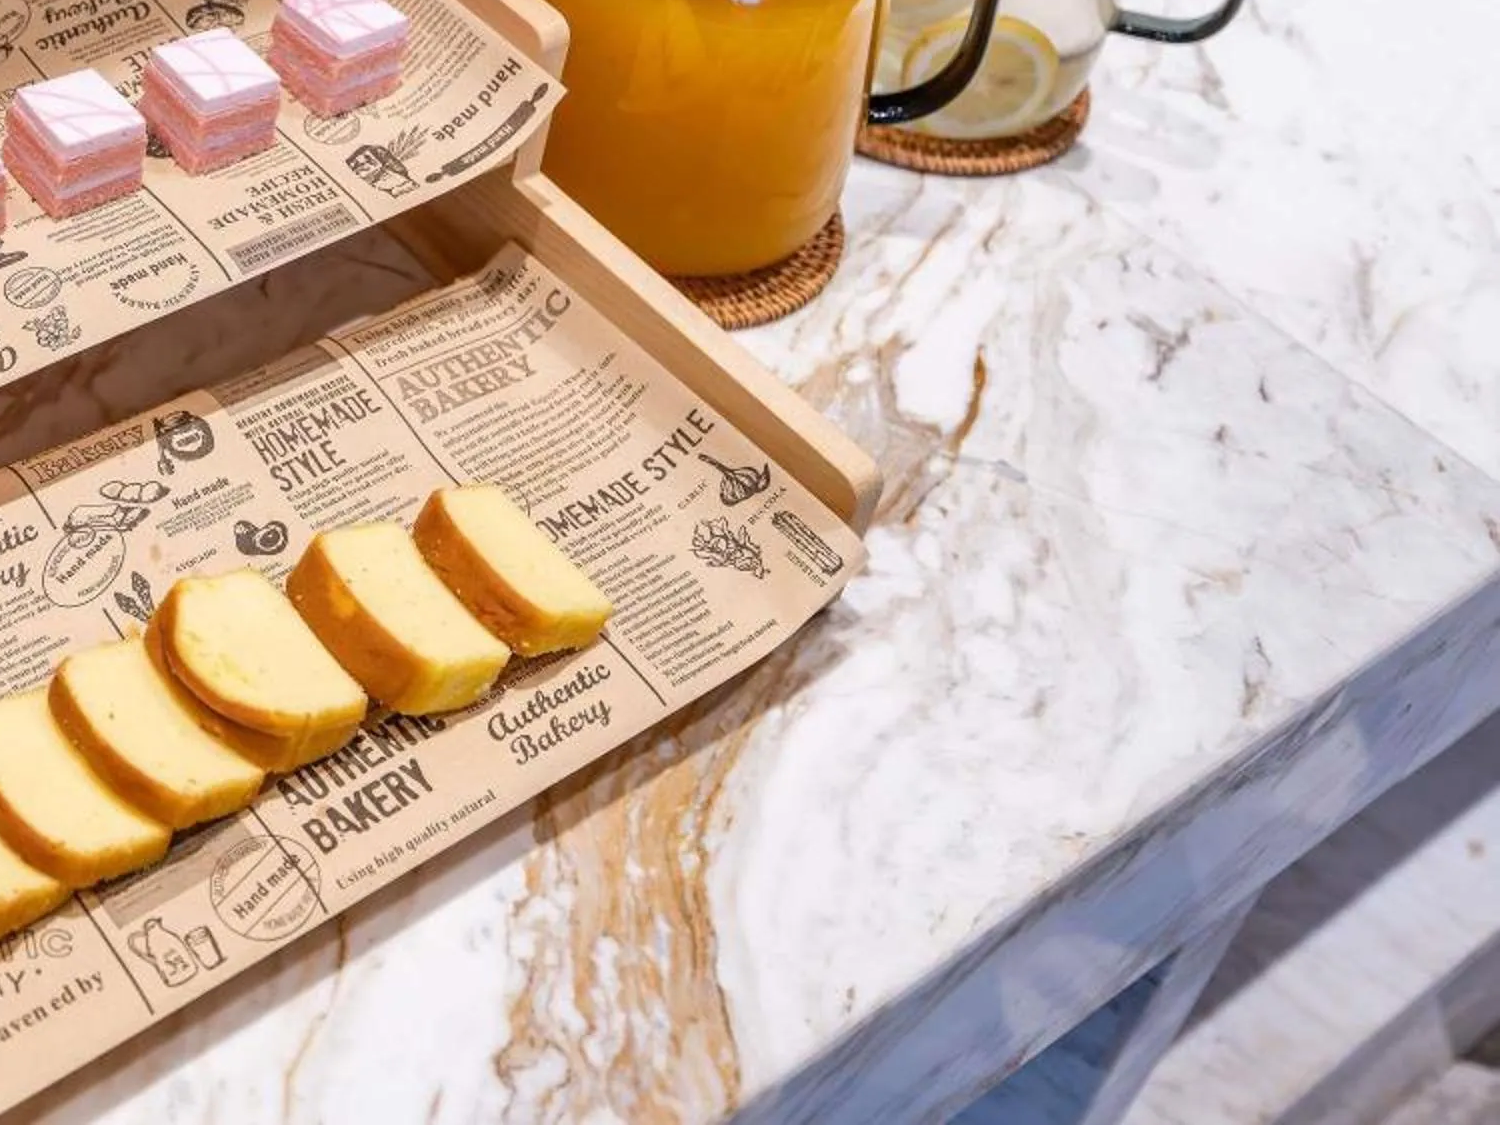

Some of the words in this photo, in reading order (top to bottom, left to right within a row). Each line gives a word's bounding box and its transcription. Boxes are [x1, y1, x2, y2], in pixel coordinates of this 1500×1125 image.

[34, 0, 150, 50] Authentic
[477, 58, 522, 106] Hand
[431, 103, 478, 138] made
[207, 175, 326, 231] HOMEMADE
[244, 164, 314, 197] RECIPE
[276, 187, 338, 220] FRESH
[256, 211, 274, 227] &
[109, 267, 149, 292] made
[148, 252, 187, 276] Hand
[397, 287, 570, 401] AUTHENTIC
[407, 352, 537, 424] BAKERY
[251, 387, 382, 466] HOMEMADE
[643, 407, 715, 483] STYLE
[170, 487, 201, 510] Hand
[199, 473, 230, 496] made
[268, 439, 346, 494] STYLE
[56, 557, 86, 584] Hand
[85, 533, 113, 560] made
[490, 664, 611, 742] Authentic
[510, 700, 610, 763] Bakery
[300, 756, 435, 856] BAKERY
[334, 860, 376, 892] Using
[372, 842, 405, 870] high
[402, 816, 450, 851] quality
[447, 787, 497, 824] natural
[233, 880, 269, 919] Hand
[266, 854, 301, 887] made
[47, 985, 77, 1012] ed
[75, 967, 108, 999] by
